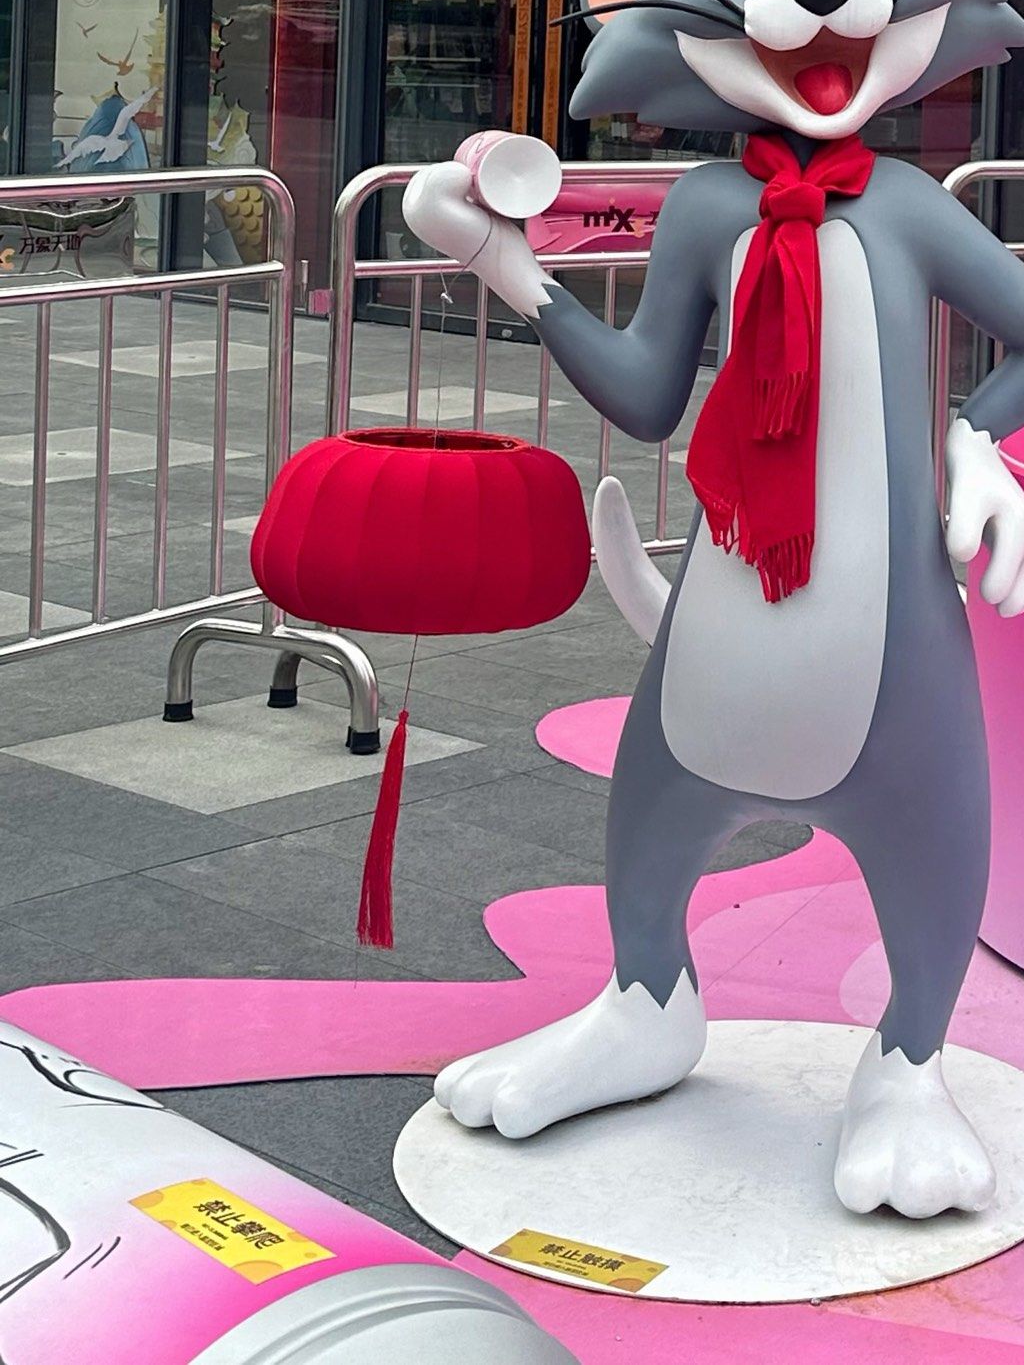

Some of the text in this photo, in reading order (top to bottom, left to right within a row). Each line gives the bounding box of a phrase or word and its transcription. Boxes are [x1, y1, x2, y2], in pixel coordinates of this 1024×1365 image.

[192, 1199, 286, 1250] 禁止攀爬
[538, 1243, 626, 1272] 禁止触摸
